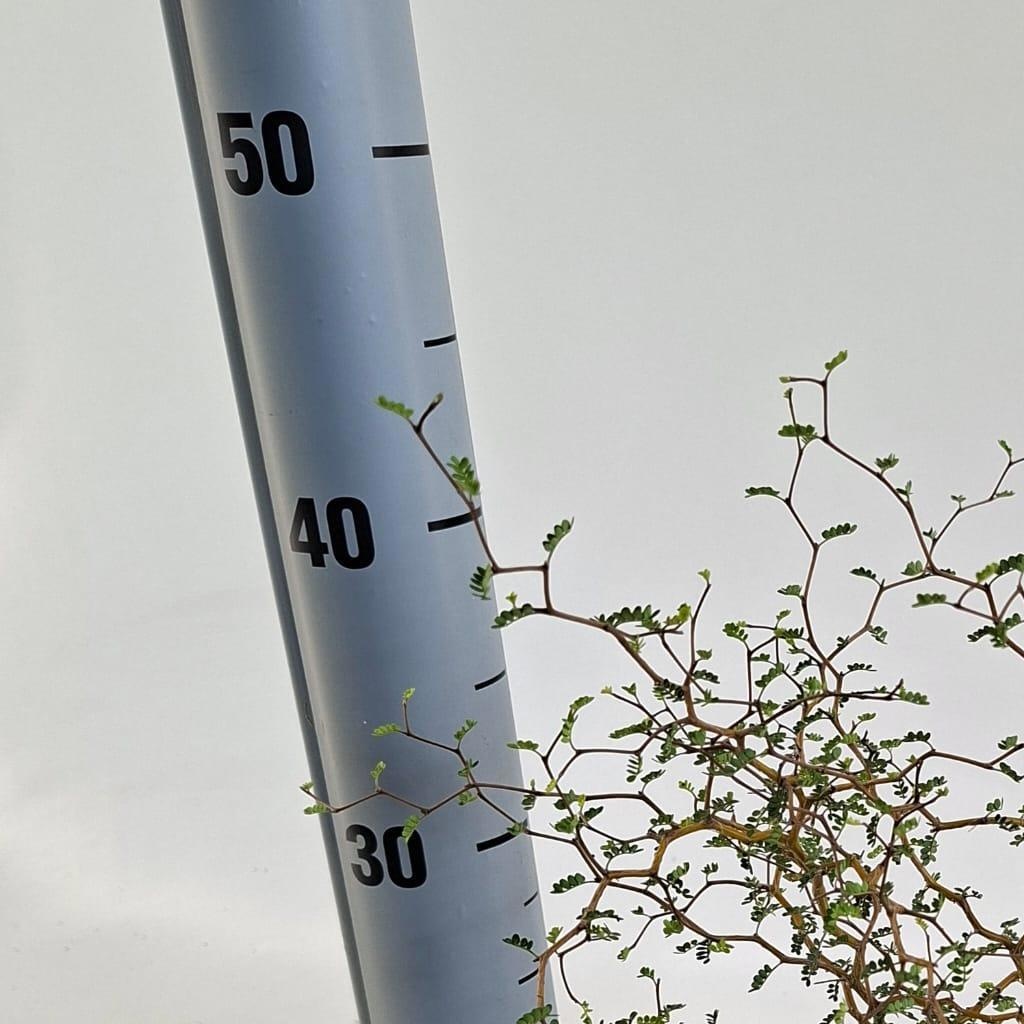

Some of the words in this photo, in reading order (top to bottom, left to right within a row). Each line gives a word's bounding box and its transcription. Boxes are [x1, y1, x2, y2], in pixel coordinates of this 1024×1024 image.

[217, 110, 315, 196] 50
[289, 496, 376, 570] 40
[345, 824, 428, 889] 30
